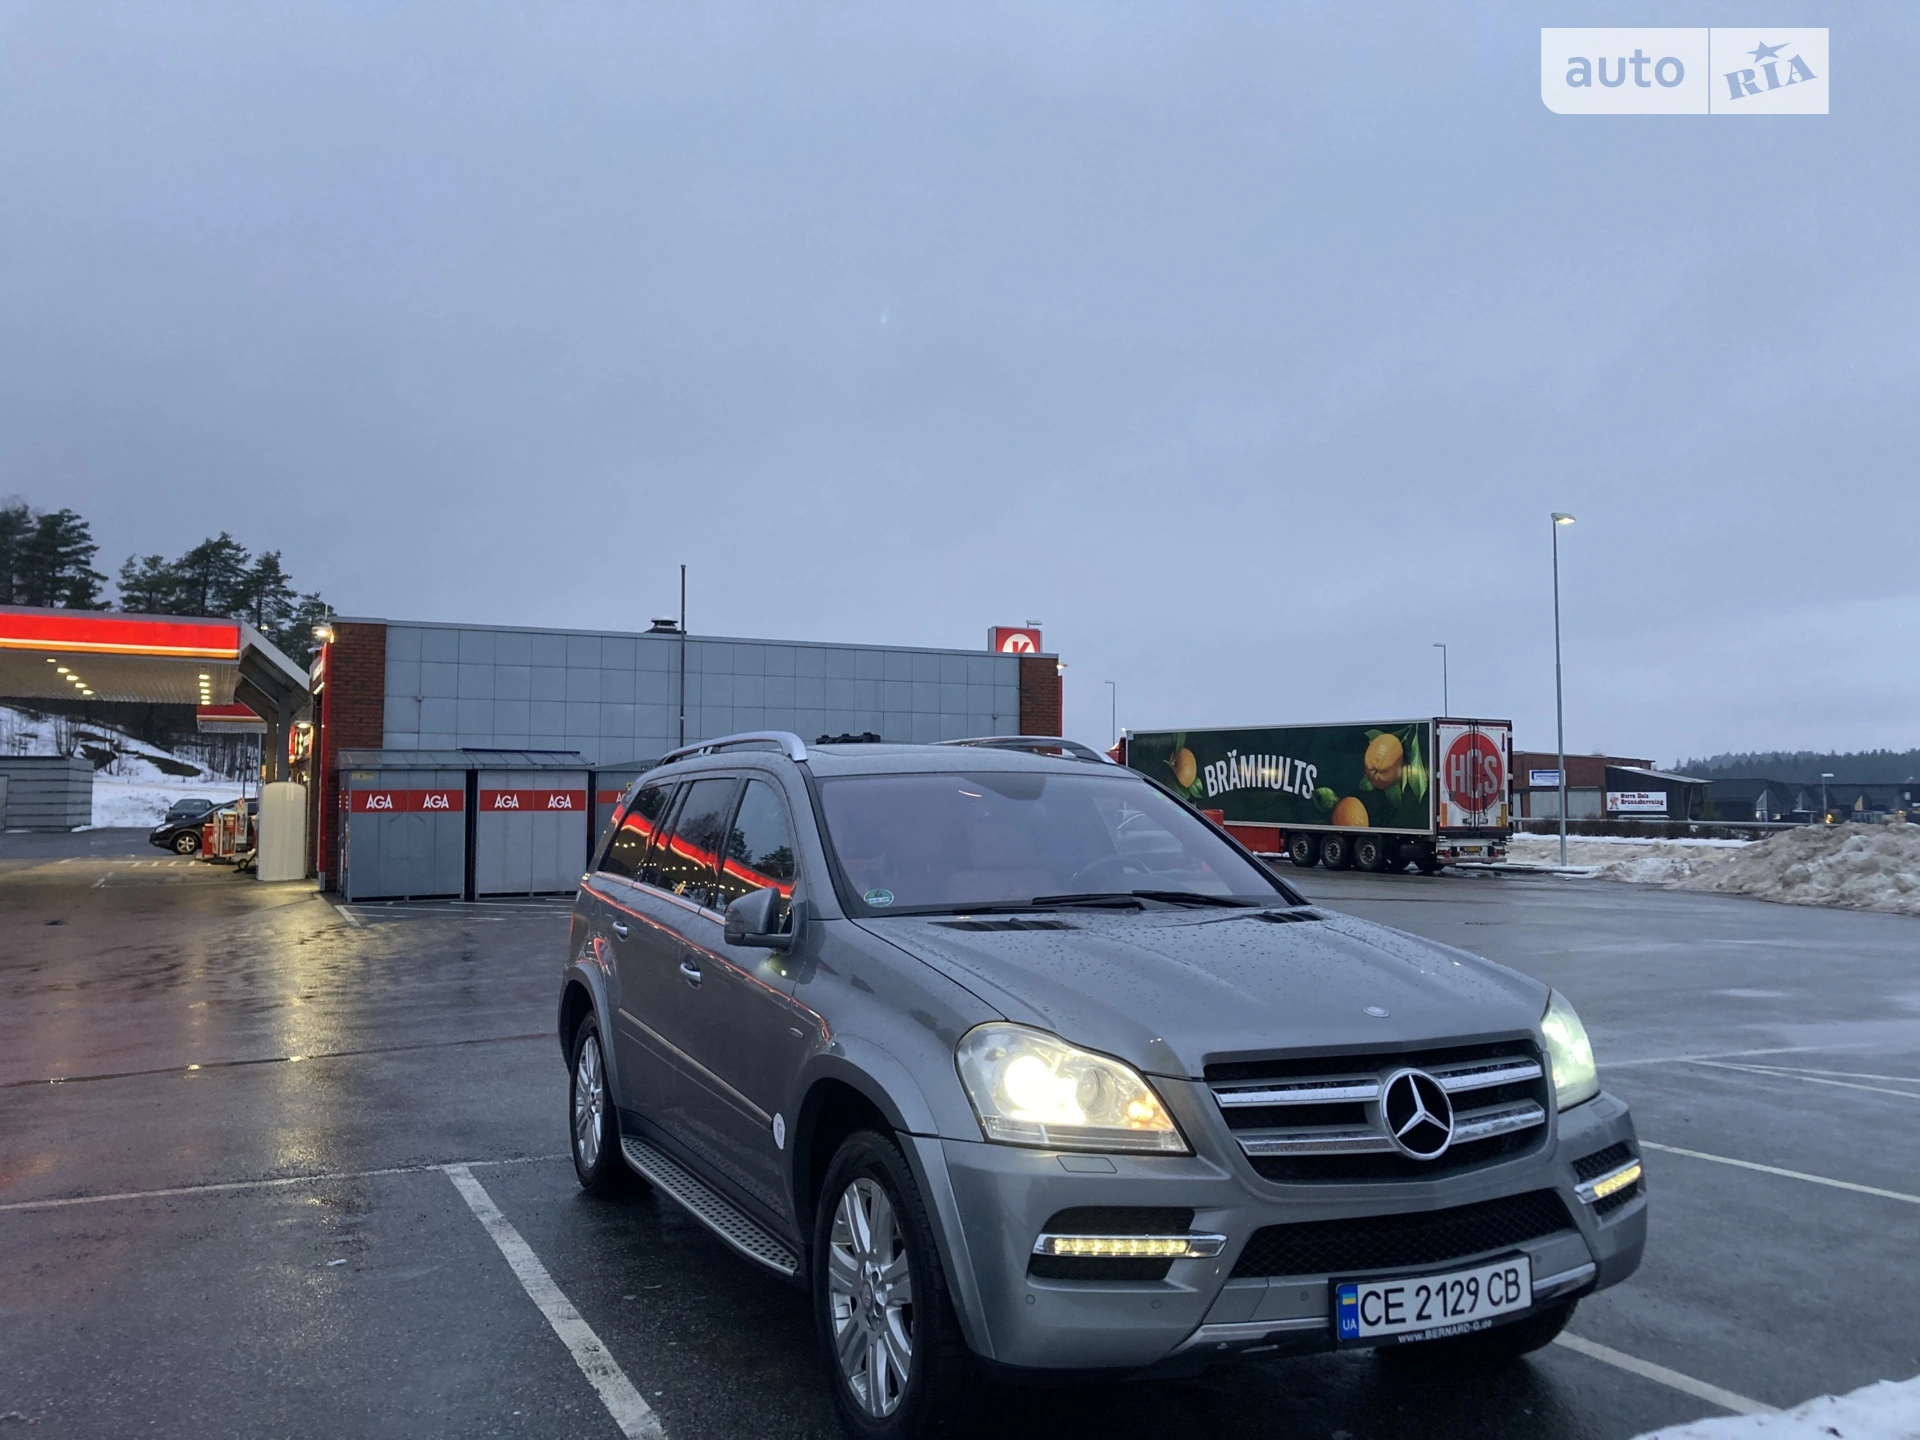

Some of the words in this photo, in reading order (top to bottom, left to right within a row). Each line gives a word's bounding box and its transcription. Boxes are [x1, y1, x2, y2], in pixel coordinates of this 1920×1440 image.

[1203, 748, 1318, 800] BRÄMHULTS
[1450, 748, 1498, 799] HCS
[366, 793, 393, 809] AGA
[423, 793, 449, 809] AGA
[494, 793, 519, 809] AGA
[547, 793, 572, 809] AGA
[1360, 1287, 1407, 1327] CE
[1414, 1276, 1480, 1322] 2129
[1487, 1268, 1521, 1307] CB
[1342, 1318, 1358, 1331] UA
